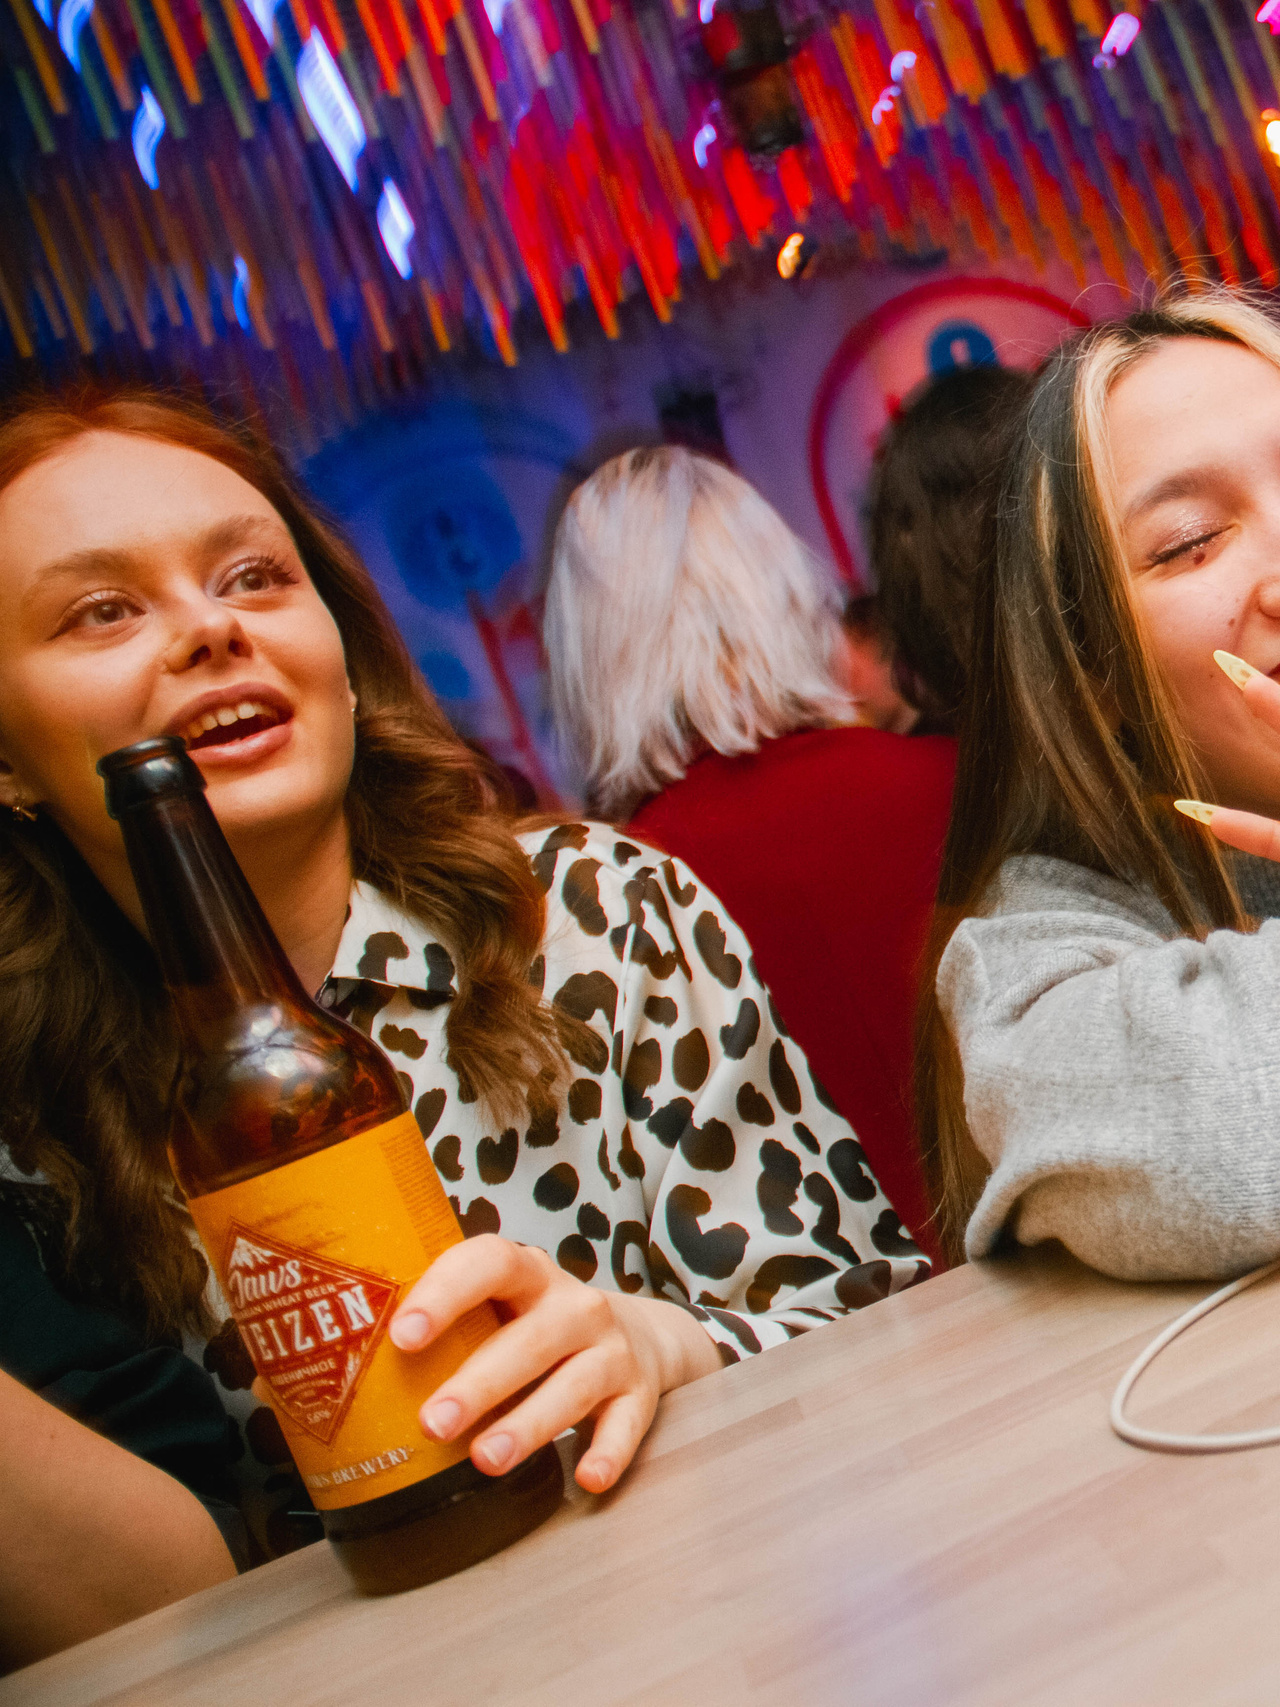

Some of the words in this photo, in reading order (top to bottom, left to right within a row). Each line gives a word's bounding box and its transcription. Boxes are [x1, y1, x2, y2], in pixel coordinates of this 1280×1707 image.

[228, 1259, 302, 1309] Jaws
[263, 1292, 301, 1313] WHEAT
[304, 1283, 337, 1299] BEER
[332, 1447, 408, 1485] BREWERY
